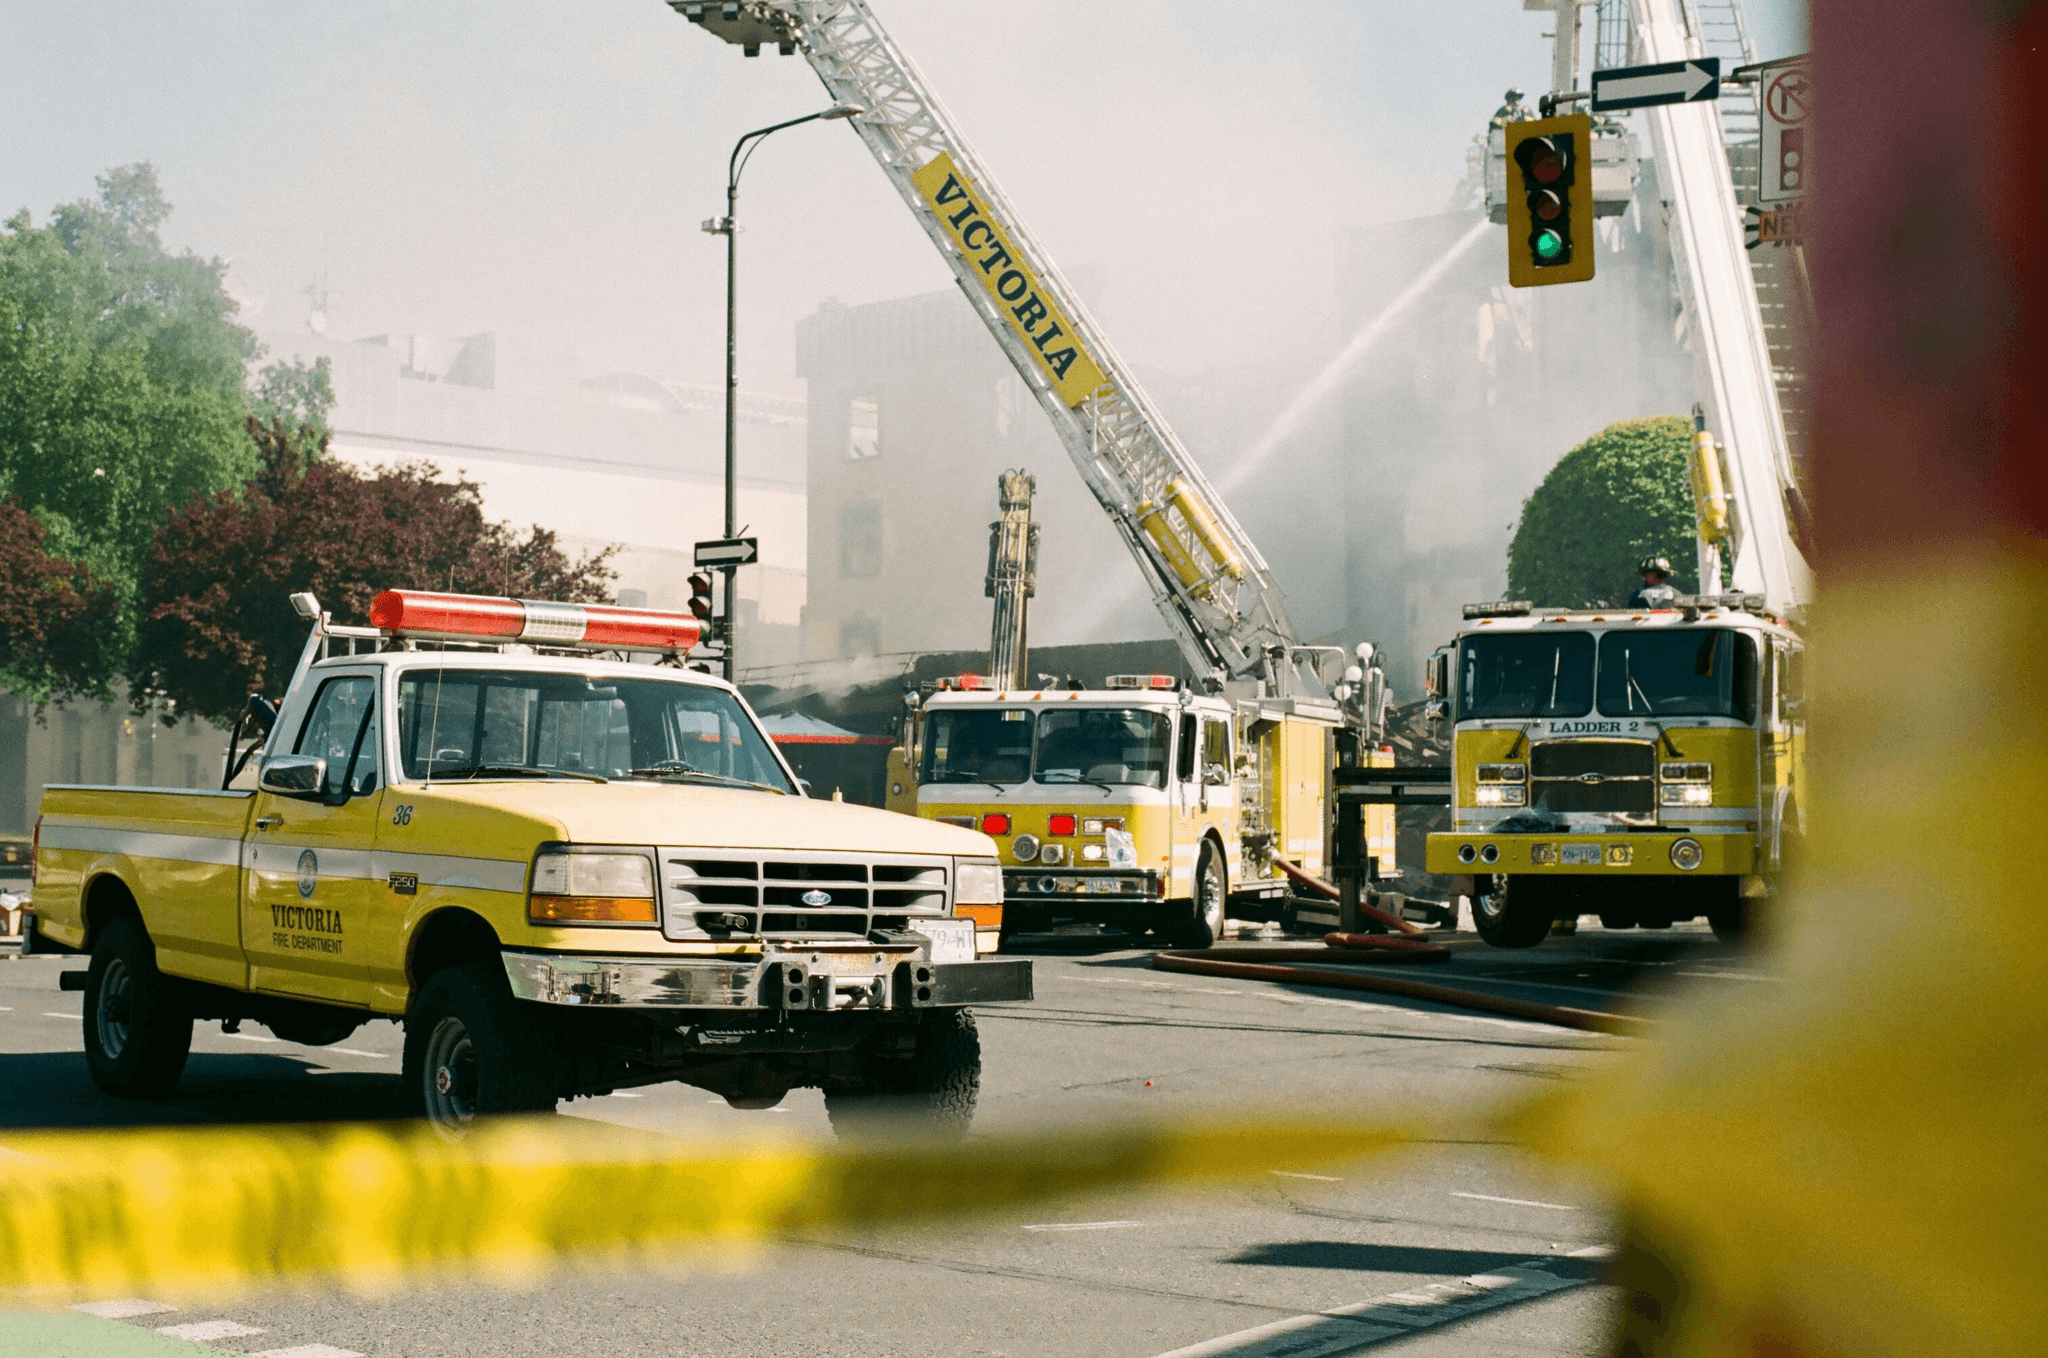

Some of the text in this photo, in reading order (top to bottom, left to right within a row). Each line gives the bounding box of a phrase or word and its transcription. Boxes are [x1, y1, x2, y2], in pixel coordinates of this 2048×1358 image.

[1763, 215, 1801, 236] NE
[934, 173, 1078, 381] VICTORIA
[1550, 721, 1640, 733] LADDER 2
[393, 804, 414, 826] 36
[388, 876, 415, 888] F250
[271, 904, 343, 934] VICTORIA
[273, 932, 343, 955] FIRE DEPARTMENT
